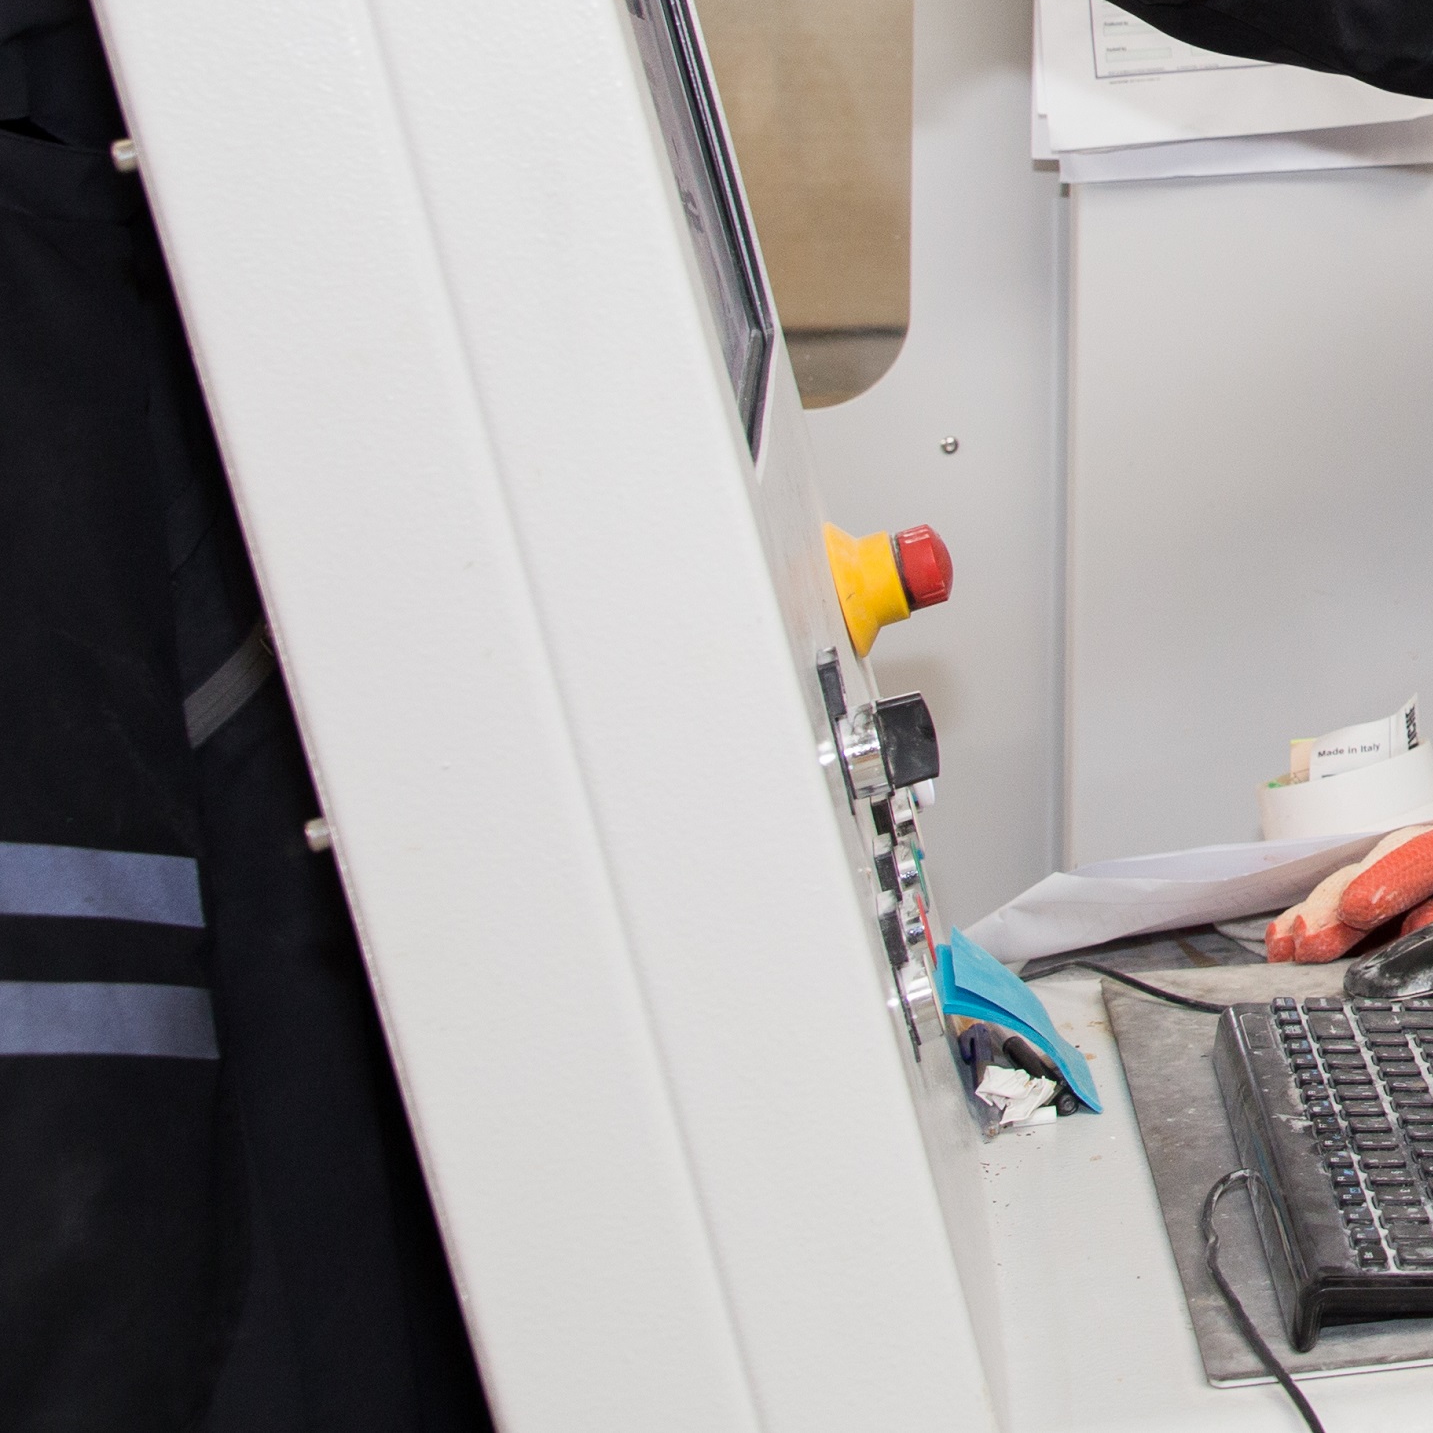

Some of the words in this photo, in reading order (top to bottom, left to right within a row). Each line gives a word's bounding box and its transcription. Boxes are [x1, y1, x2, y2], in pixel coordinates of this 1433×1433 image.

[1317, 748, 1345, 758] Made
[1347, 745, 1358, 755] in
[1360, 743, 1381, 753] Italy
